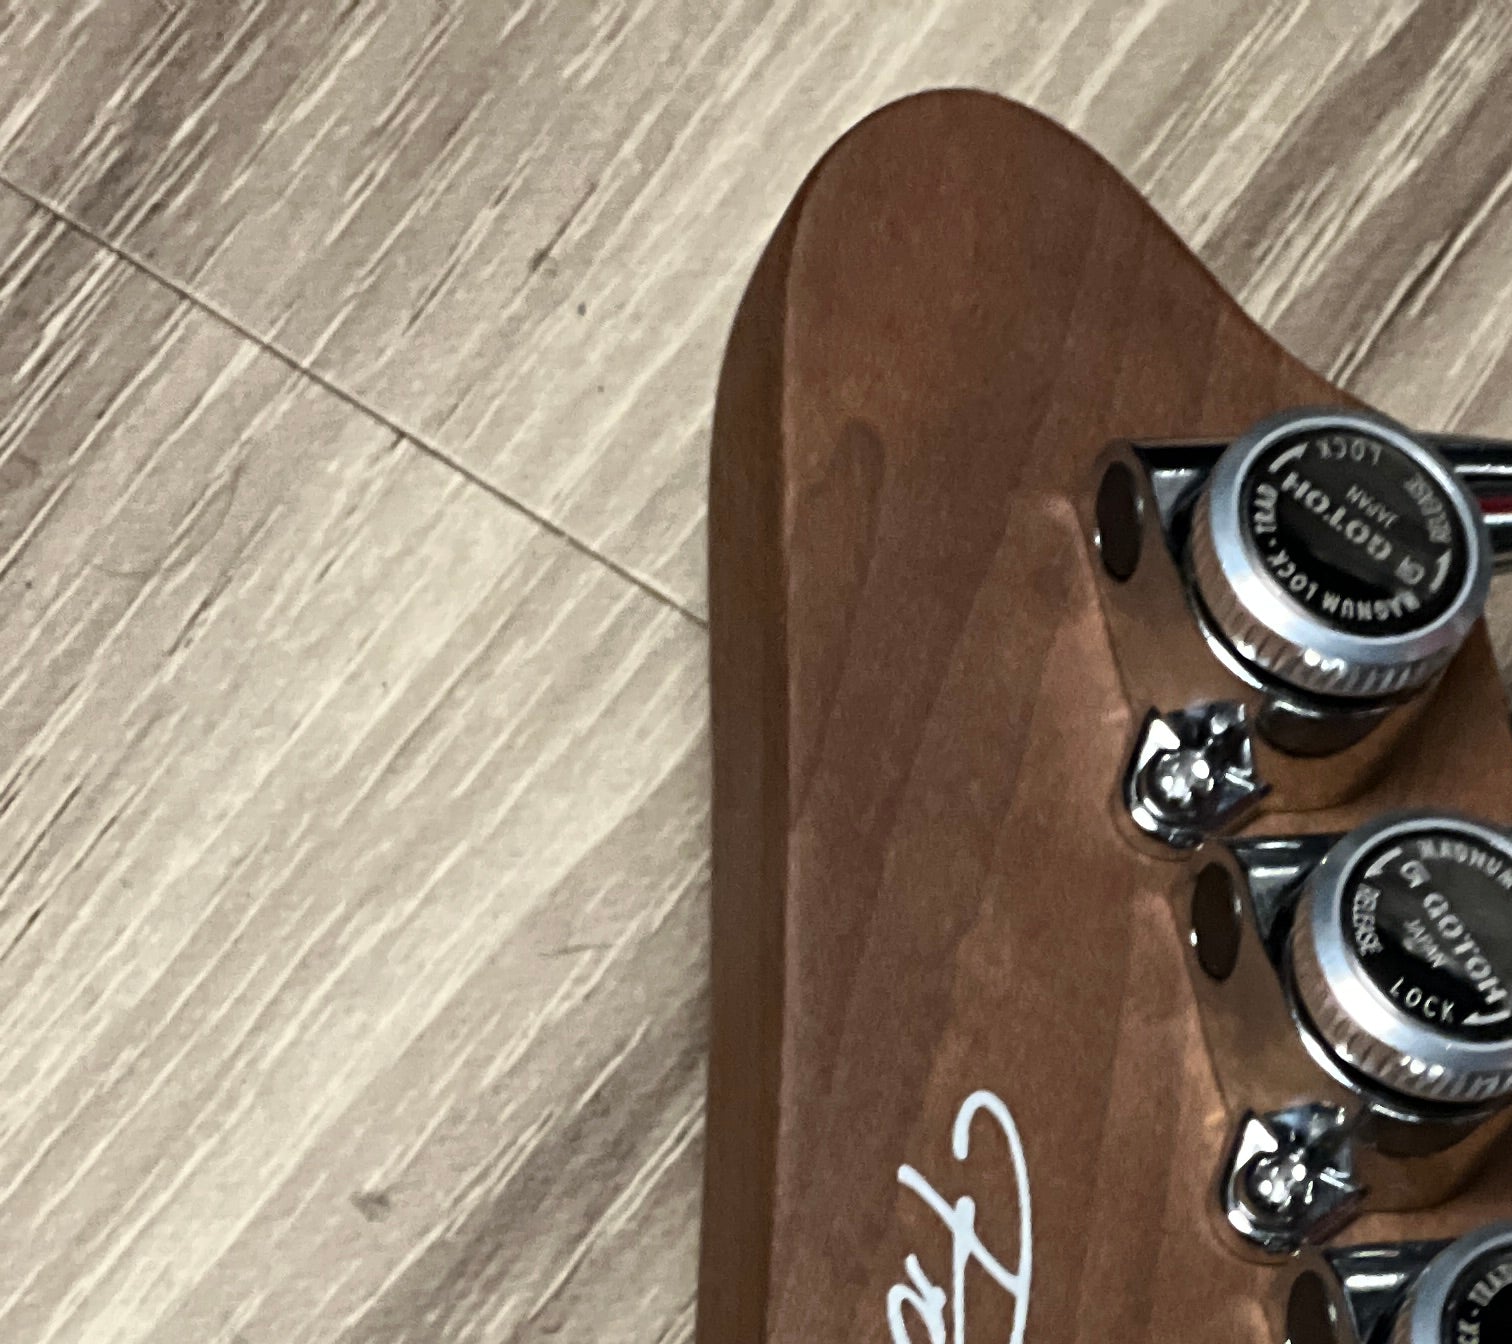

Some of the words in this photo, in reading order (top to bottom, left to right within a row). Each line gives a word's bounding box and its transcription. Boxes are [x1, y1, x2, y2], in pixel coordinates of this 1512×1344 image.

[1316, 437, 1382, 466] LOCK
[1280, 471, 1392, 560] GOTOH
[1268, 550, 1319, 601] LOCK
[1423, 892, 1508, 1004] GOTOH
[1390, 976, 1454, 1023] LOCK
